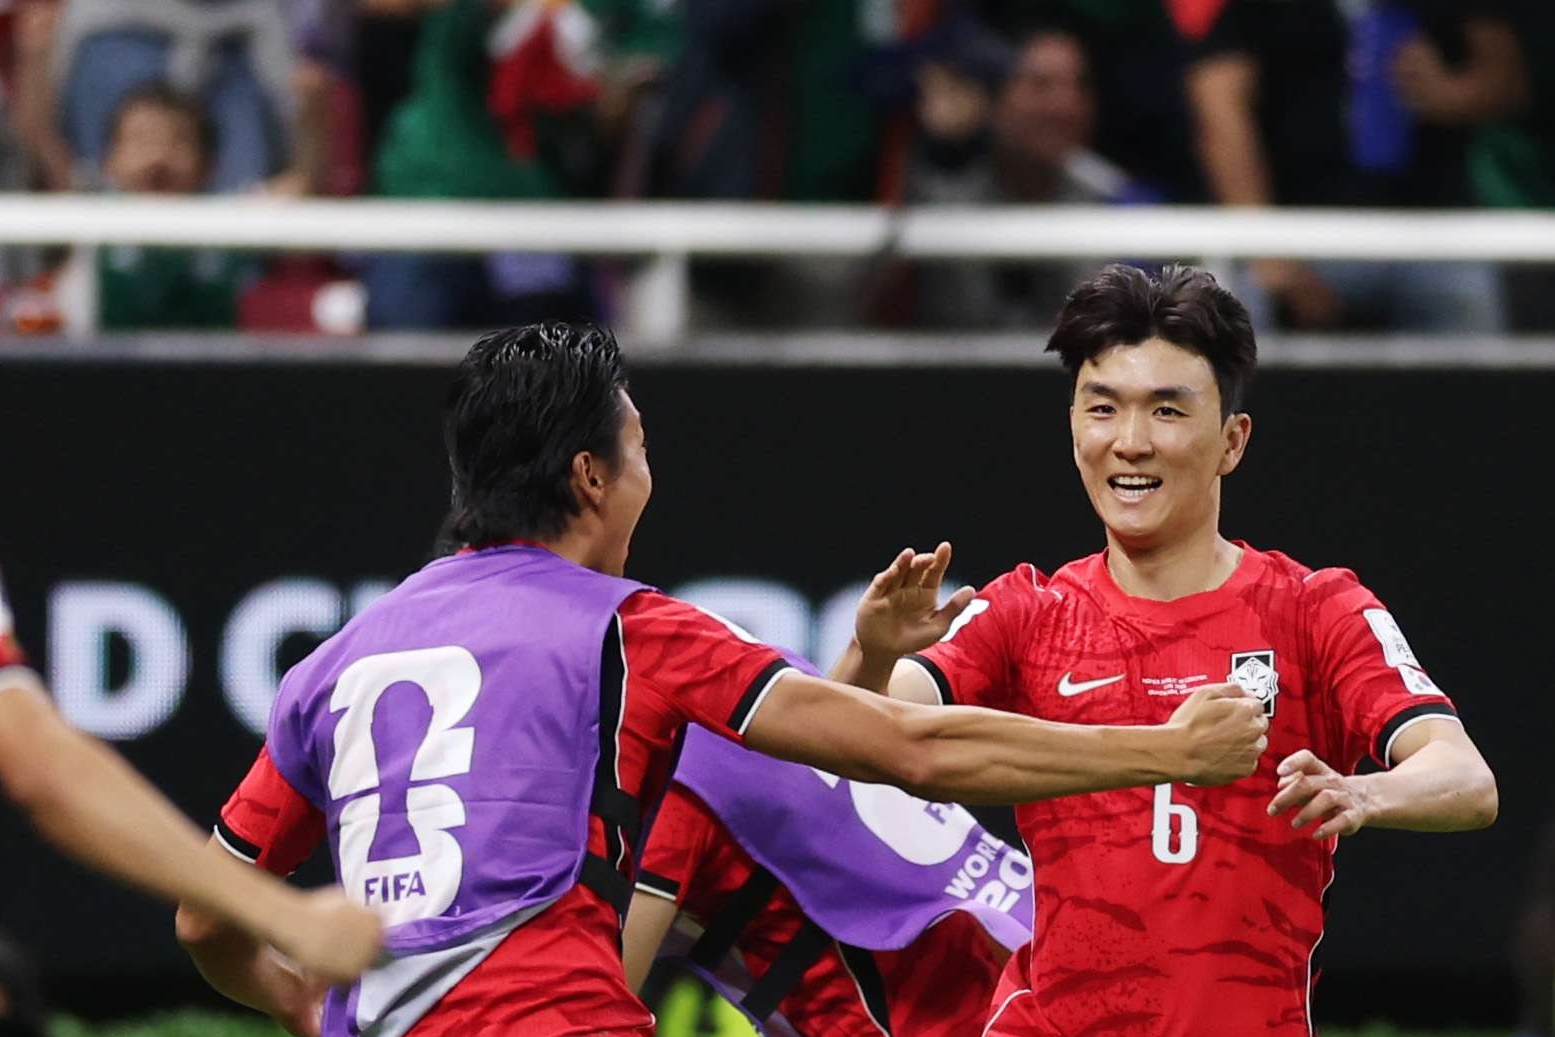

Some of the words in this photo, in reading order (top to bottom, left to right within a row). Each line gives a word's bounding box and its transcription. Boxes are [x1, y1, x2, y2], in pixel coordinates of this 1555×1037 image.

[1151, 782, 1199, 864] 6
[364, 870, 426, 906] FIFA
[944, 831, 1006, 900] WORL
[974, 849, 1034, 913] 20
